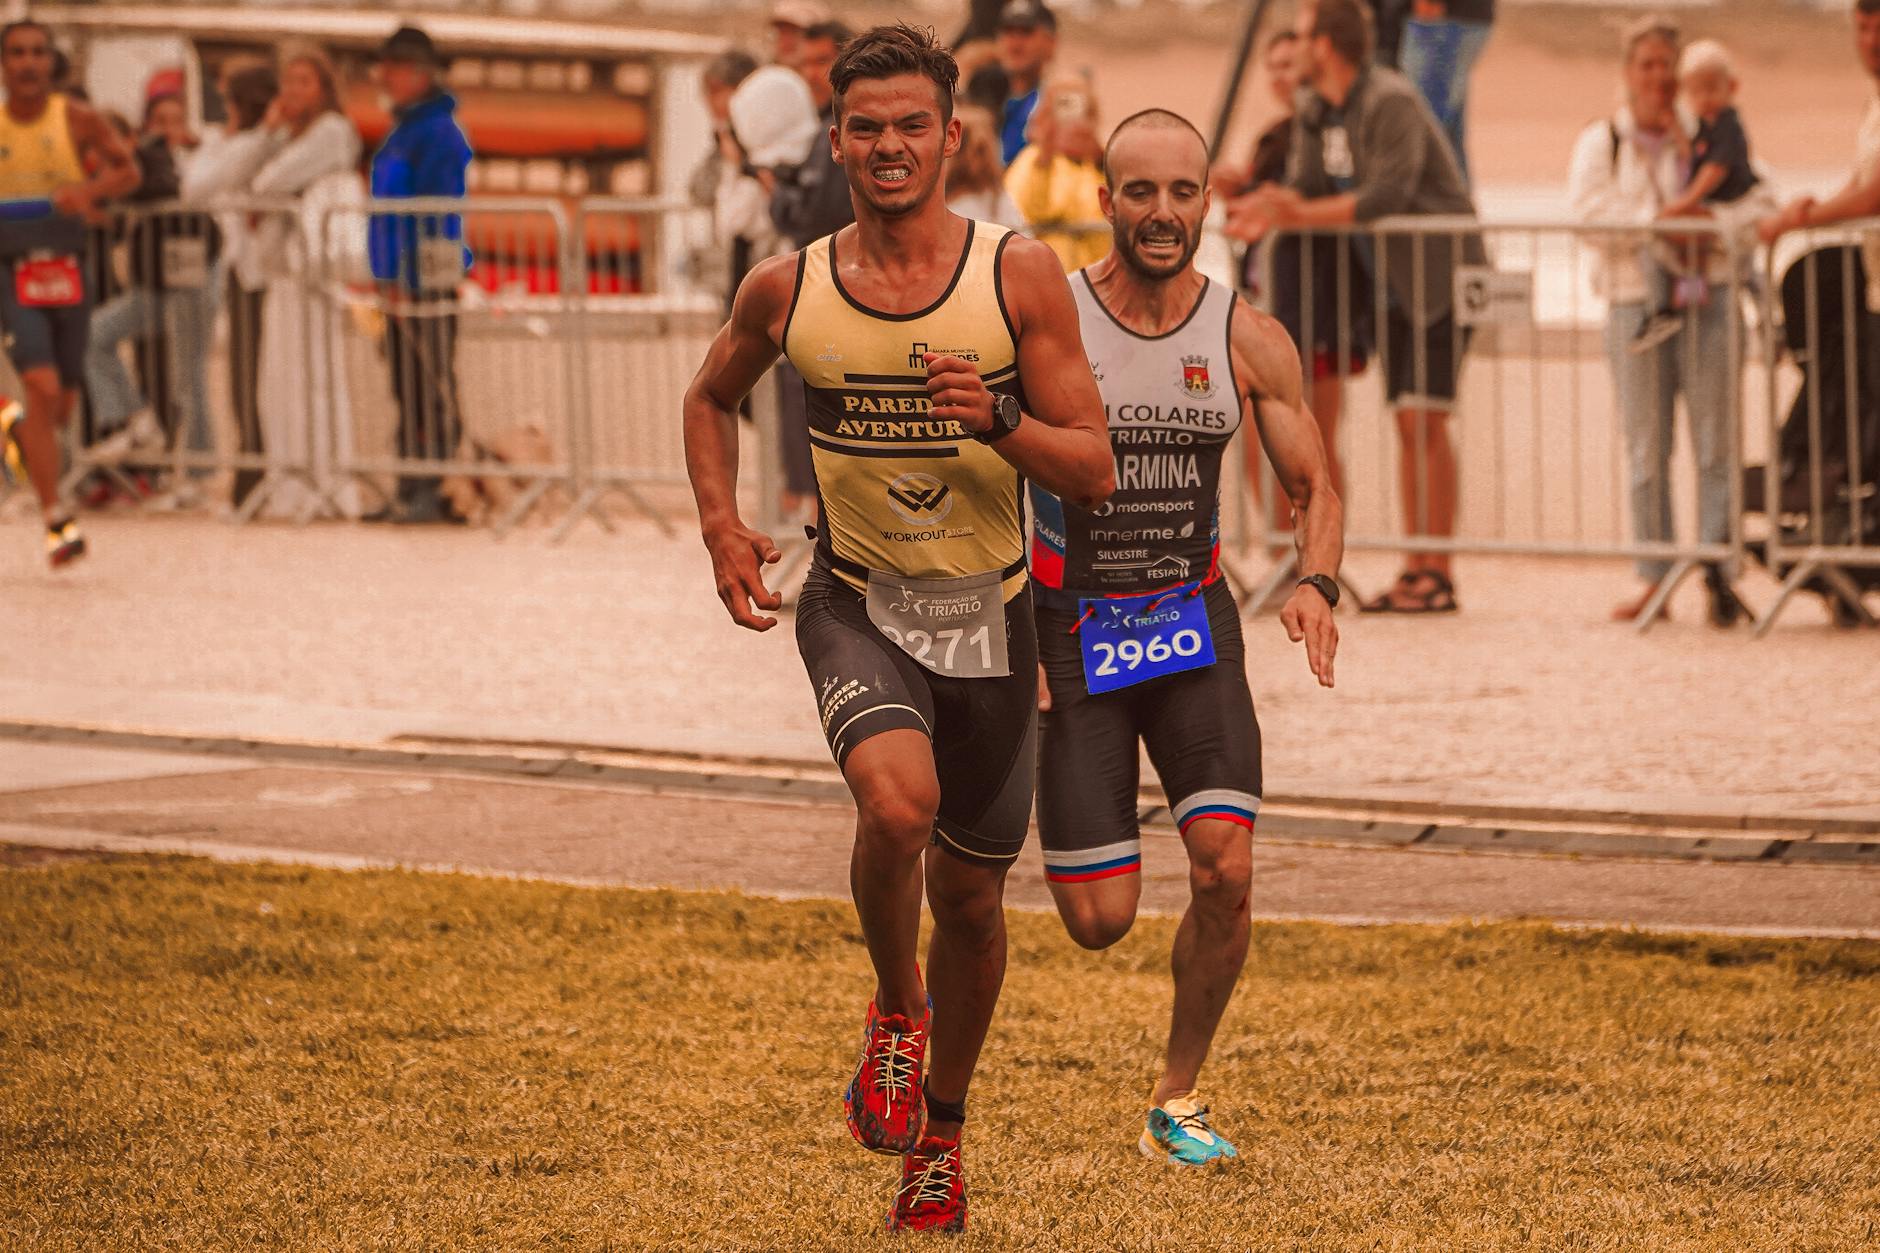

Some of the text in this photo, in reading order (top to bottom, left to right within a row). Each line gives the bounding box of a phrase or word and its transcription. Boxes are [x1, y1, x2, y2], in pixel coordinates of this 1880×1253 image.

[843, 396, 933, 414] PARED
[1118, 405, 1226, 429] COLARES
[836, 418, 965, 438] AVENTUR
[1117, 500, 1195, 514] moonsport
[1034, 516, 1066, 548] OLARES
[1090, 527, 1175, 541] innerme
[1097, 550, 1148, 560] SILVESTRE
[1147, 567, 1179, 579] FESTAS
[927, 600, 981, 616] TRIATLO
[1134, 610, 1180, 628] TRIATLO
[1092, 629, 1202, 677] 2960
